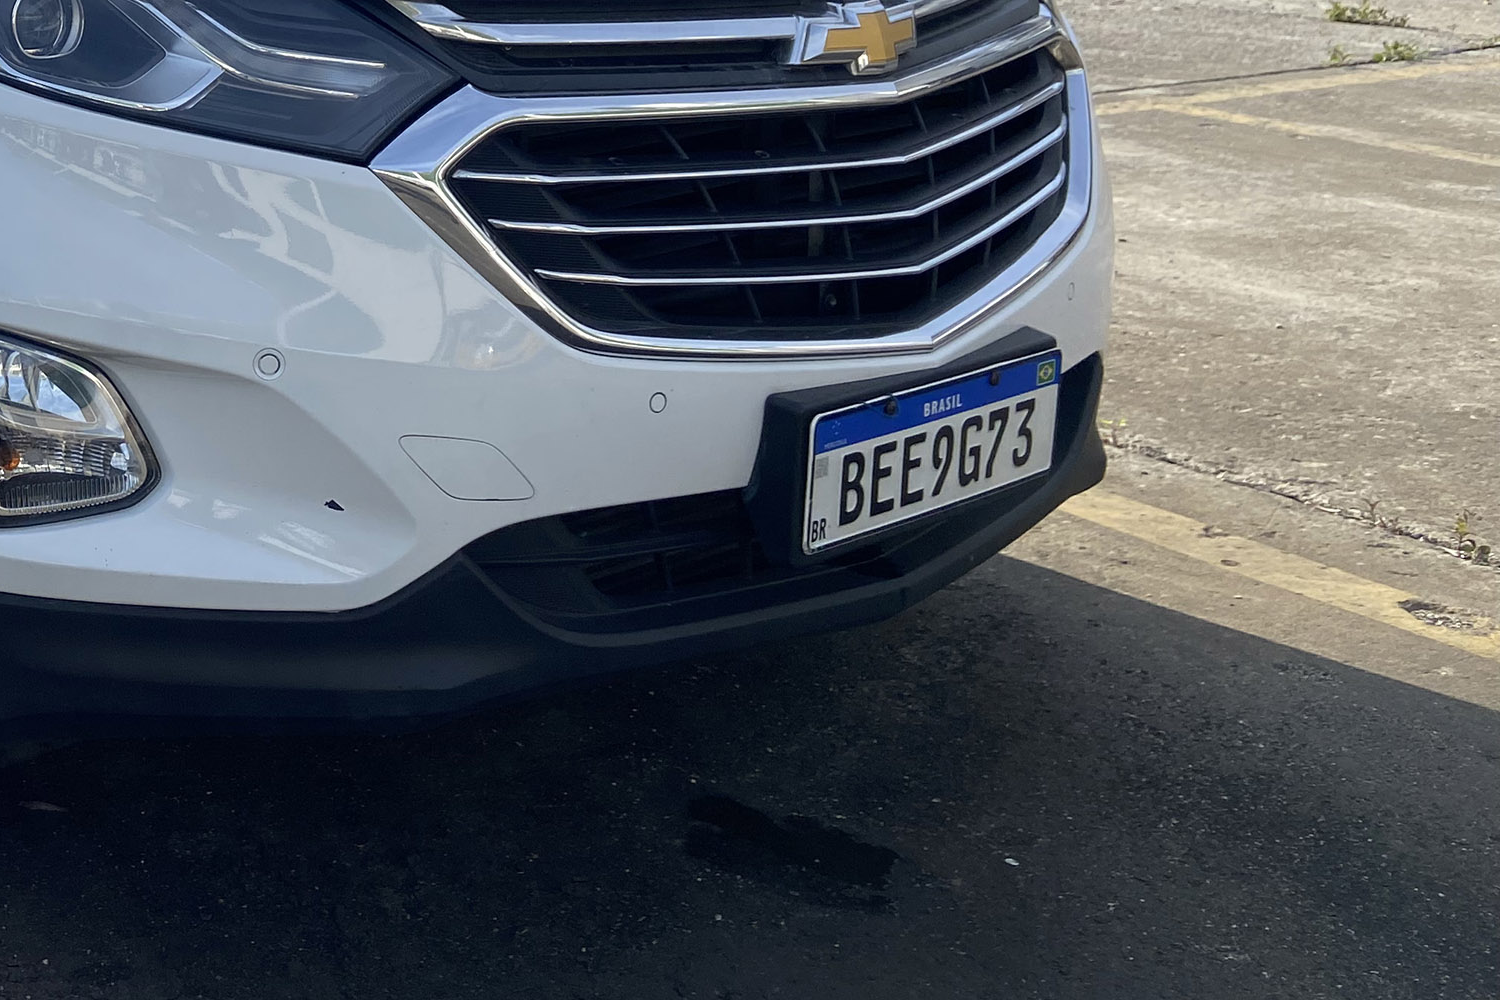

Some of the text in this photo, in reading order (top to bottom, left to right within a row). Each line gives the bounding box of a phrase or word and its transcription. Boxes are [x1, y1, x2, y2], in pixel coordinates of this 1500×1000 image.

[923, 393, 963, 418] BRASIL
[838, 398, 1036, 527] BEE9G73
[811, 517, 827, 543] BR
